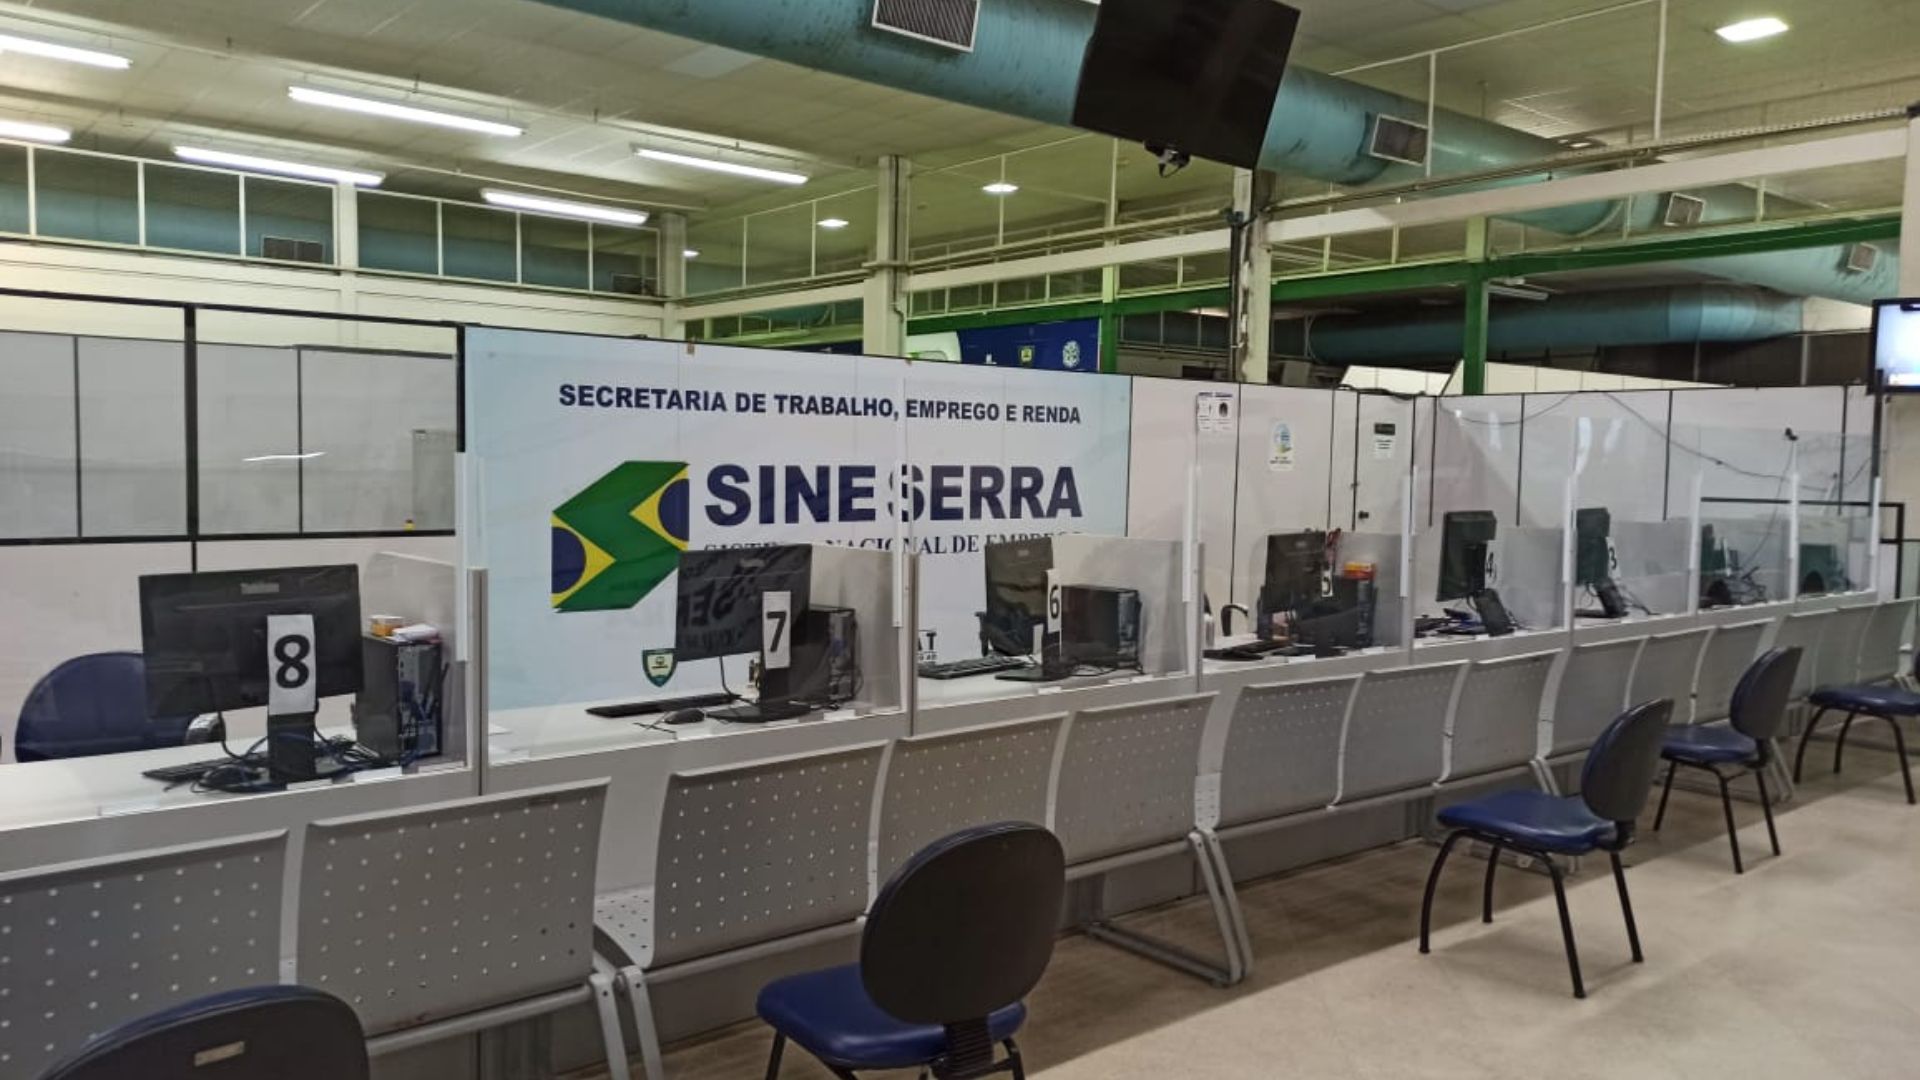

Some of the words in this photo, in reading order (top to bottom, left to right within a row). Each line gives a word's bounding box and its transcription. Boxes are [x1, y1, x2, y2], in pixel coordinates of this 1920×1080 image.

[558, 383, 728, 412] SECRETARIA
[735, 392, 766, 413] DE
[774, 394, 899, 421] TRABALHO,
[905, 399, 999, 421] EMPREGO
[1005, 404, 1017, 421] E
[1022, 405, 1081, 424] RENDA
[704, 463, 876, 526] SINE
[888, 463, 1083, 522] SERRA
[952, 534, 979, 553] DE
[1608, 546, 1617, 570] 3
[1485, 551, 1494, 578] 4
[1049, 584, 1060, 620] 6
[765, 610, 787, 653] 7
[273, 634, 311, 689] 8
